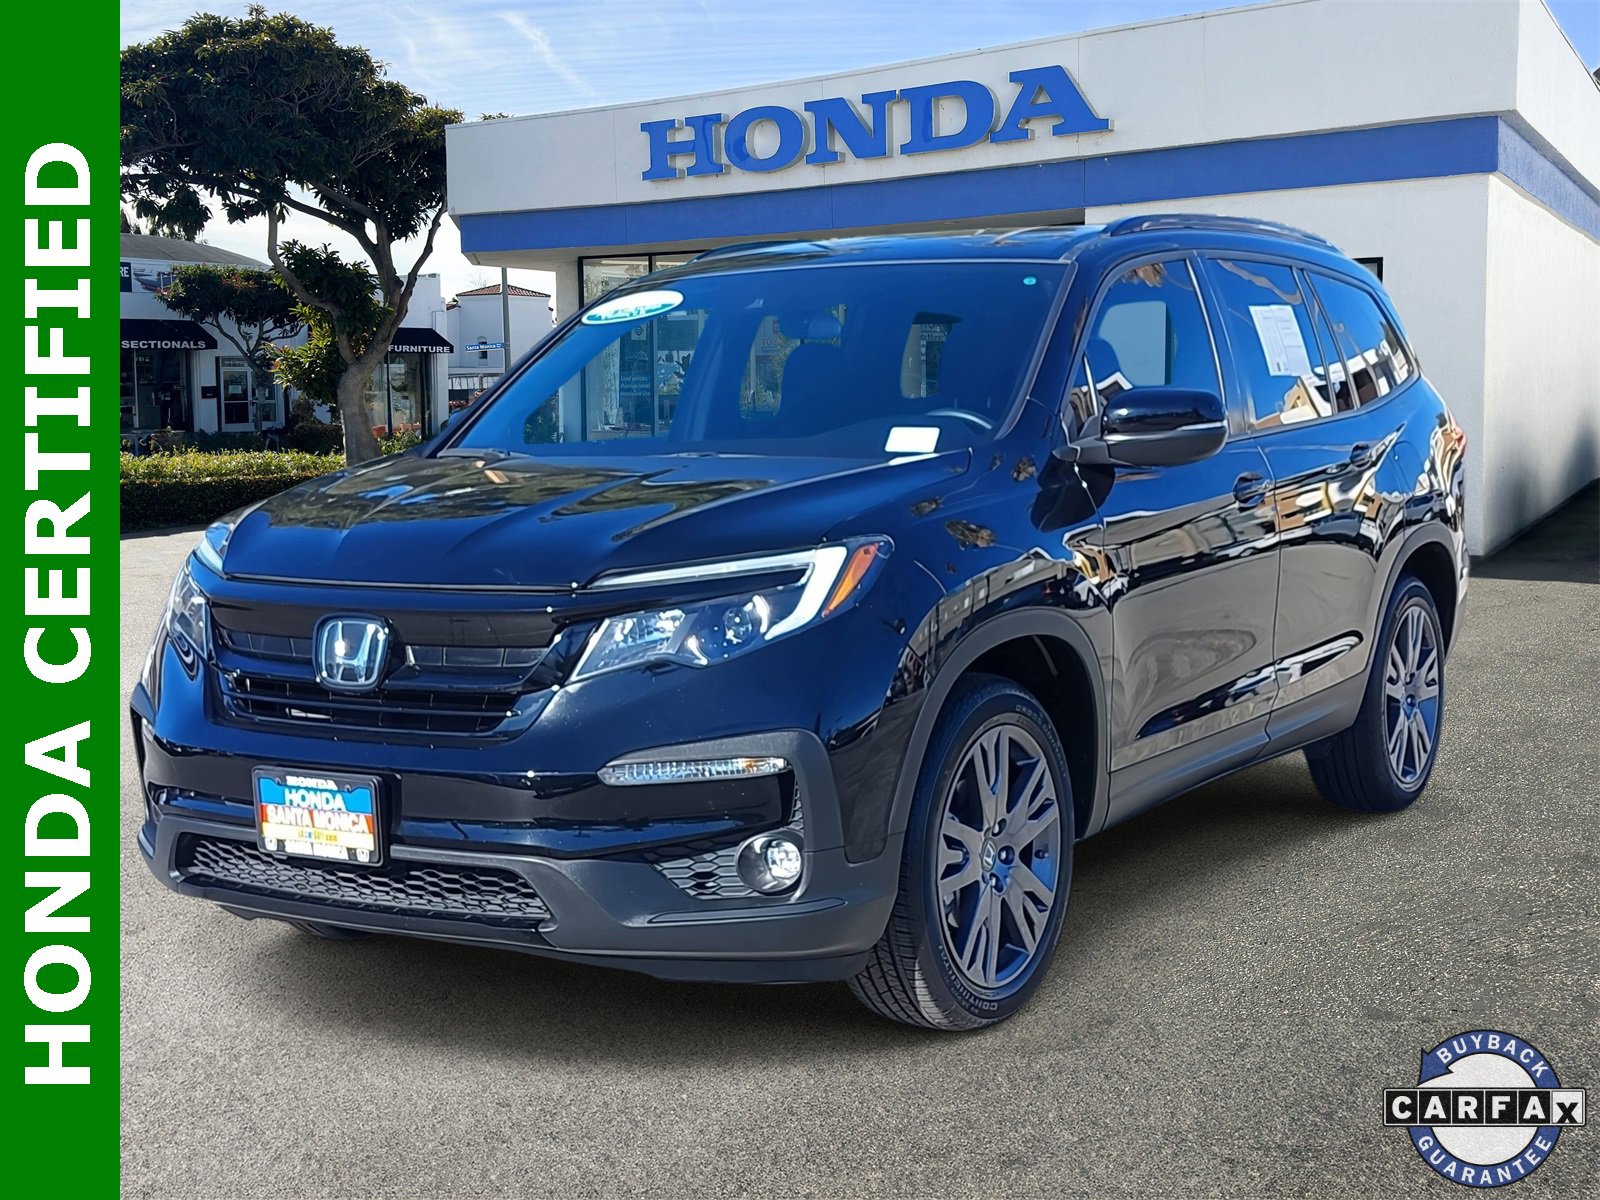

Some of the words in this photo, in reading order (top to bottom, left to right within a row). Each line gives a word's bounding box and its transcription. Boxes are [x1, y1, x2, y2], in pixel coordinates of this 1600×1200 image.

[641, 64, 1112, 182] HONDA
[121, 340, 206, 349] SECTIONALS
[388, 344, 450, 353] FURNITURE
[284, 788, 347, 812] HONDA
[266, 804, 313, 828] SANTA
[313, 808, 370, 834] MONICA
